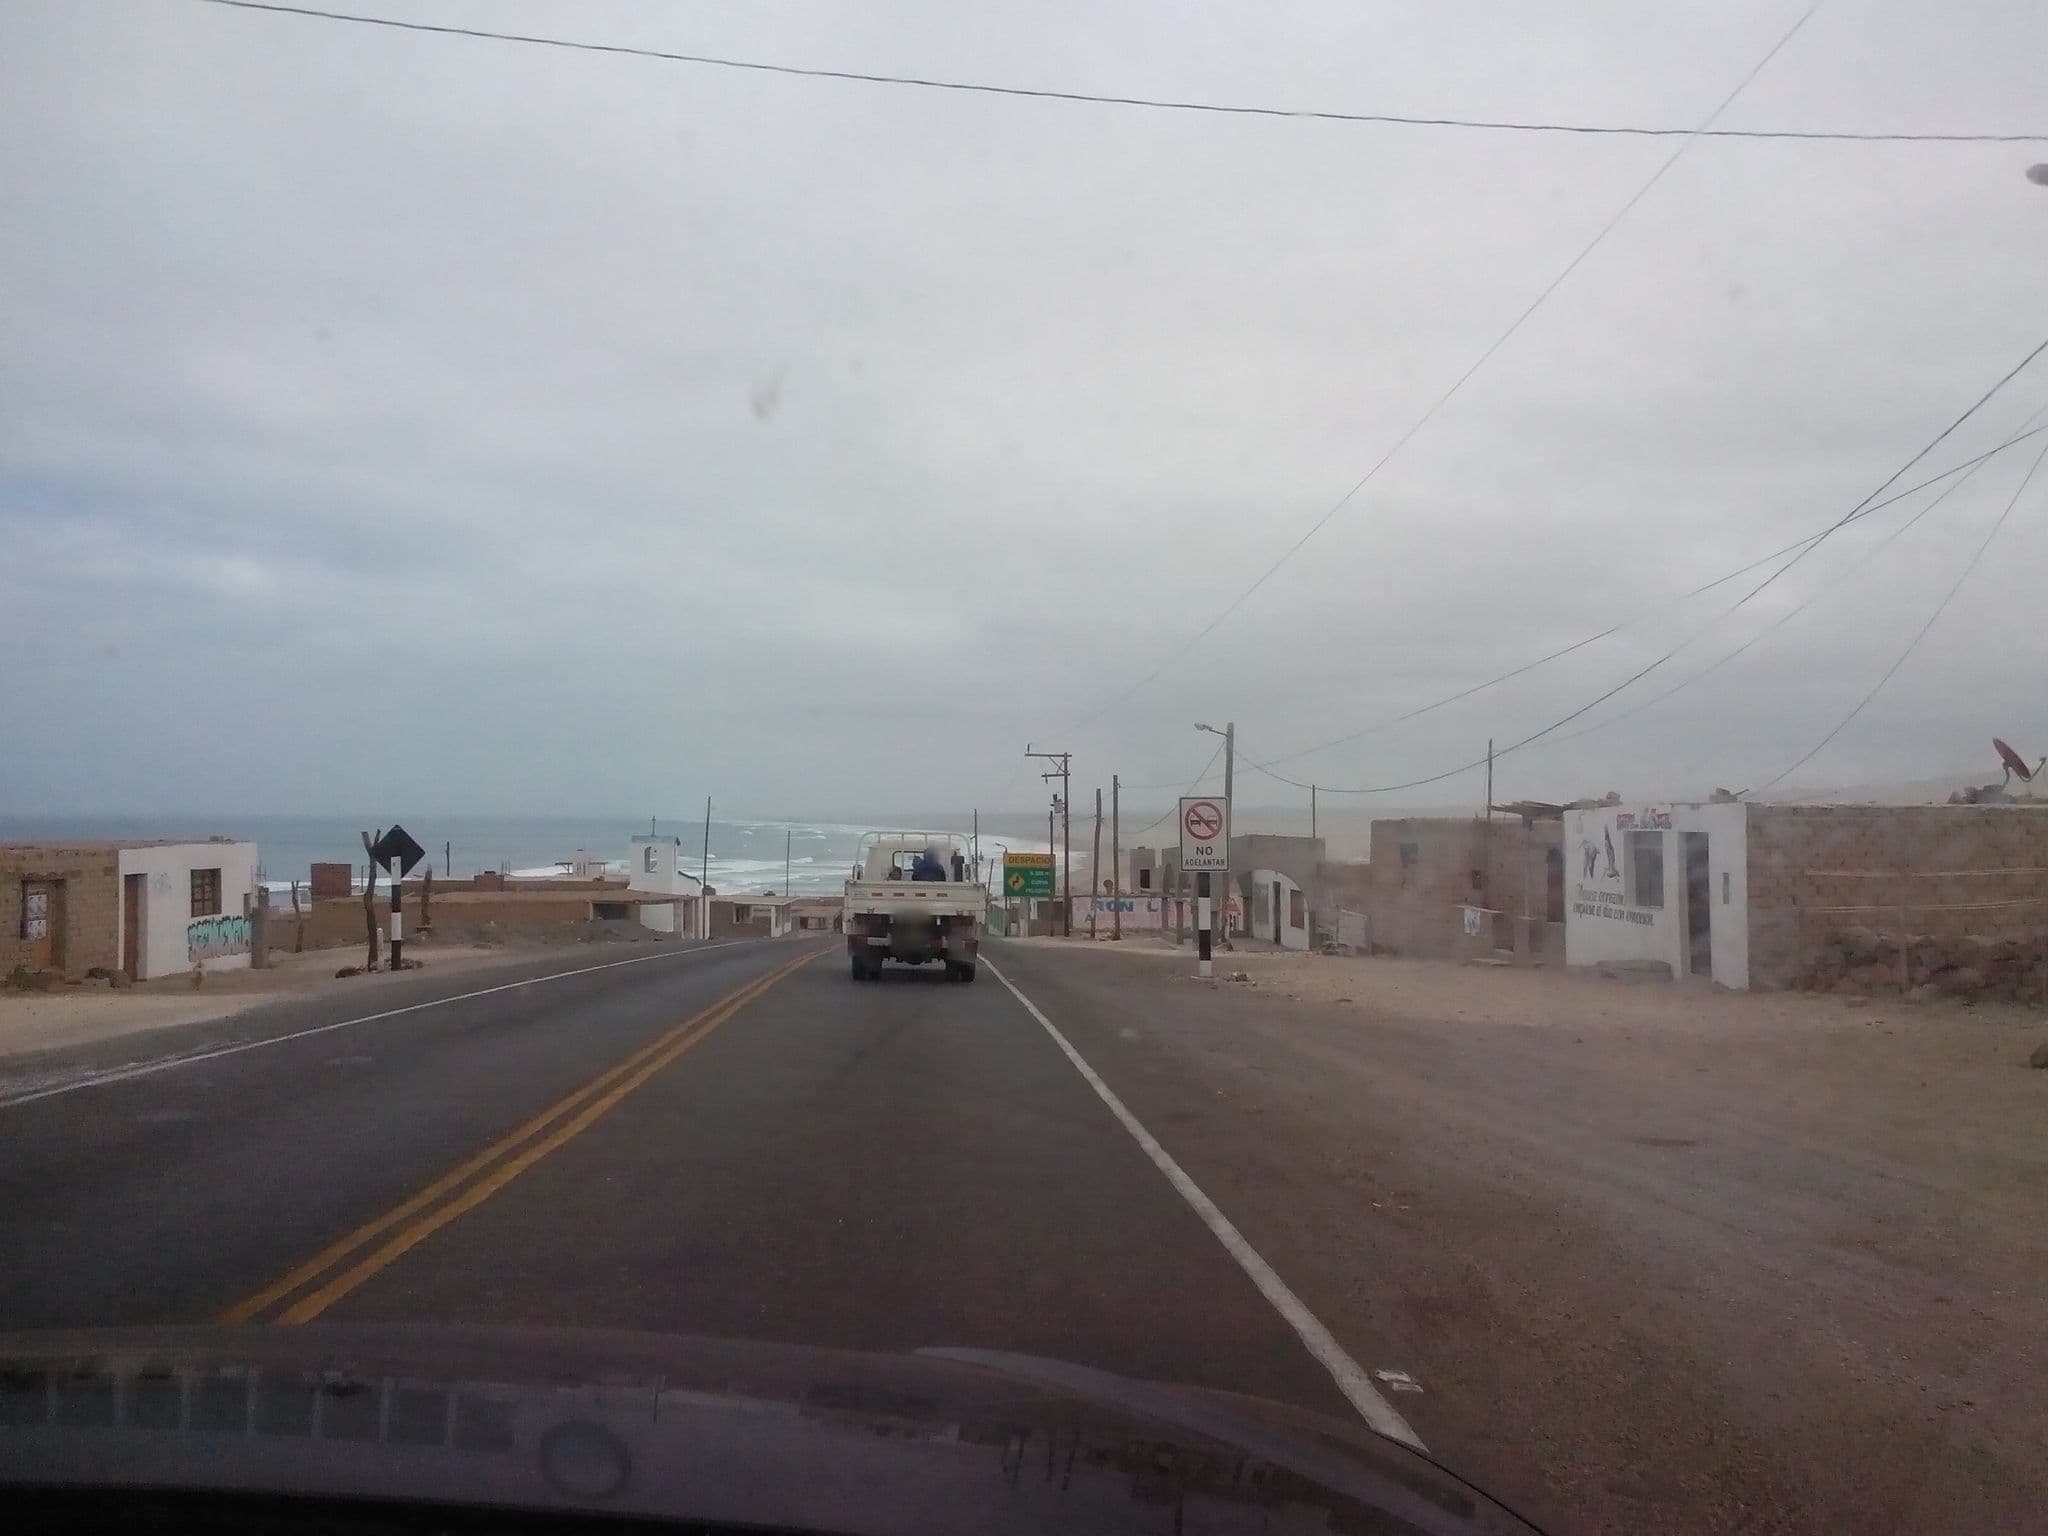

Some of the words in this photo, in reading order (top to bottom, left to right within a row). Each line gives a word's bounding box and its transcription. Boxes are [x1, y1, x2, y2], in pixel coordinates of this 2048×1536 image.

[1196, 846, 1213, 856] NO
[1008, 855, 1050, 864] DESPACIO
[1184, 858, 1225, 867] ADELANTAR
